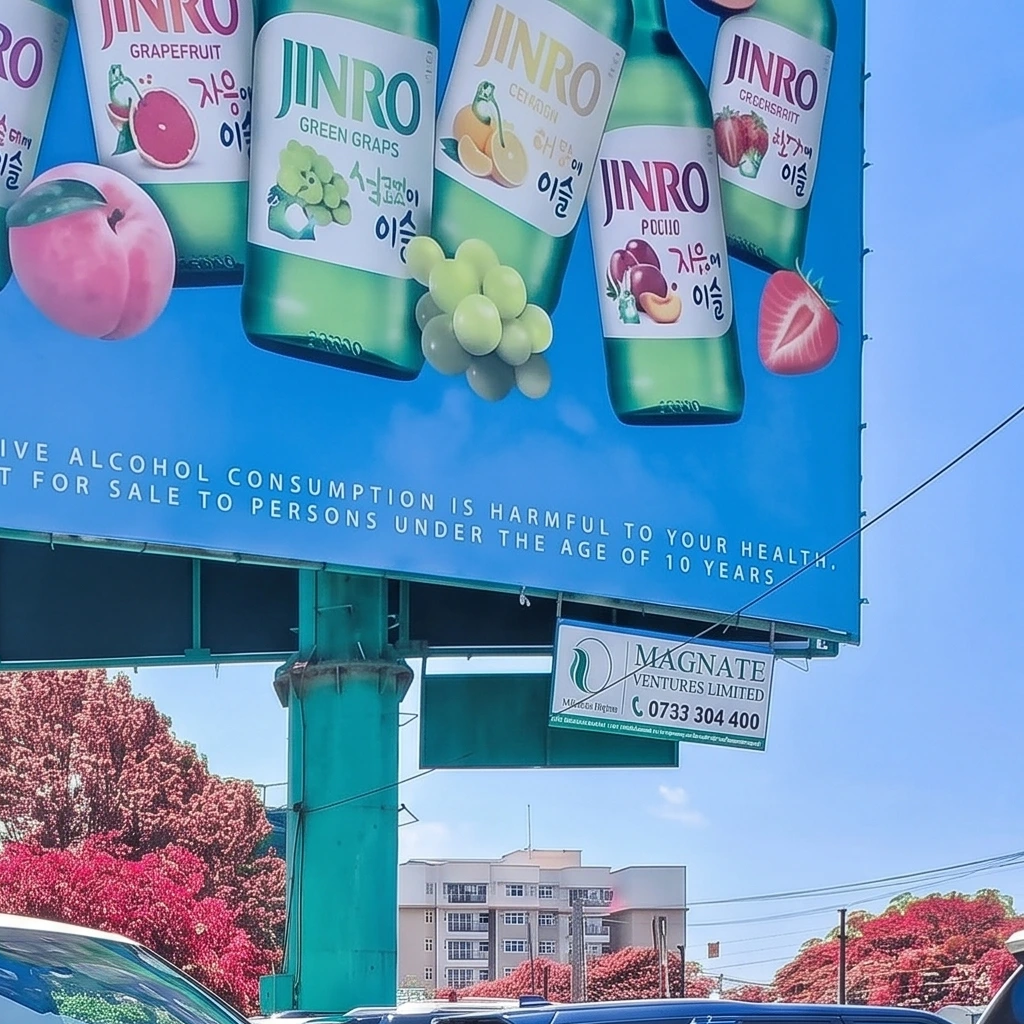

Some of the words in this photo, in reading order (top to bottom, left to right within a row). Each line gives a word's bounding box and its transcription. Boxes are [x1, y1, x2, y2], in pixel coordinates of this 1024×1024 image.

[130, 44, 221, 60] GRAPEFRUIT
[474, 4, 602, 117] JINRO
[723, 34, 818, 111] JINRO
[275, 38, 421, 136] JINRO
[300, 117, 347, 144] GREEN
[352, 131, 399, 158] GRAPS
[600, 159, 710, 227] JINRO
[33, 470, 89, 495] FOR
[109, 479, 180, 506] SALE
[198, 490, 233, 512] TO
[252, 497, 377, 530] PERSONS
[395, 515, 482, 544] UNDER
[498, 529, 545, 552] THE
[560, 538, 606, 561] AGE
[621, 547, 650, 566] OF
[665, 554, 690, 573] 10
[703, 559, 774, 585] YEARS
[69, 447, 209, 482] ALCOHOL
[227, 467, 434, 511] CONSUMPTION
[451, 496, 474, 516] IS
[490, 502, 610, 536] HARMFUL
[623, 522, 653, 542] TO
[666, 528, 727, 554] YOUR
[633, 673, 704, 694] VENTURES
[708, 682, 765, 702] LIMITED
[634, 644, 766, 682] MAGNATE
[648, 701, 689, 721] 0733
[694, 706, 724, 726] 304
[728, 711, 759, 730] 400
